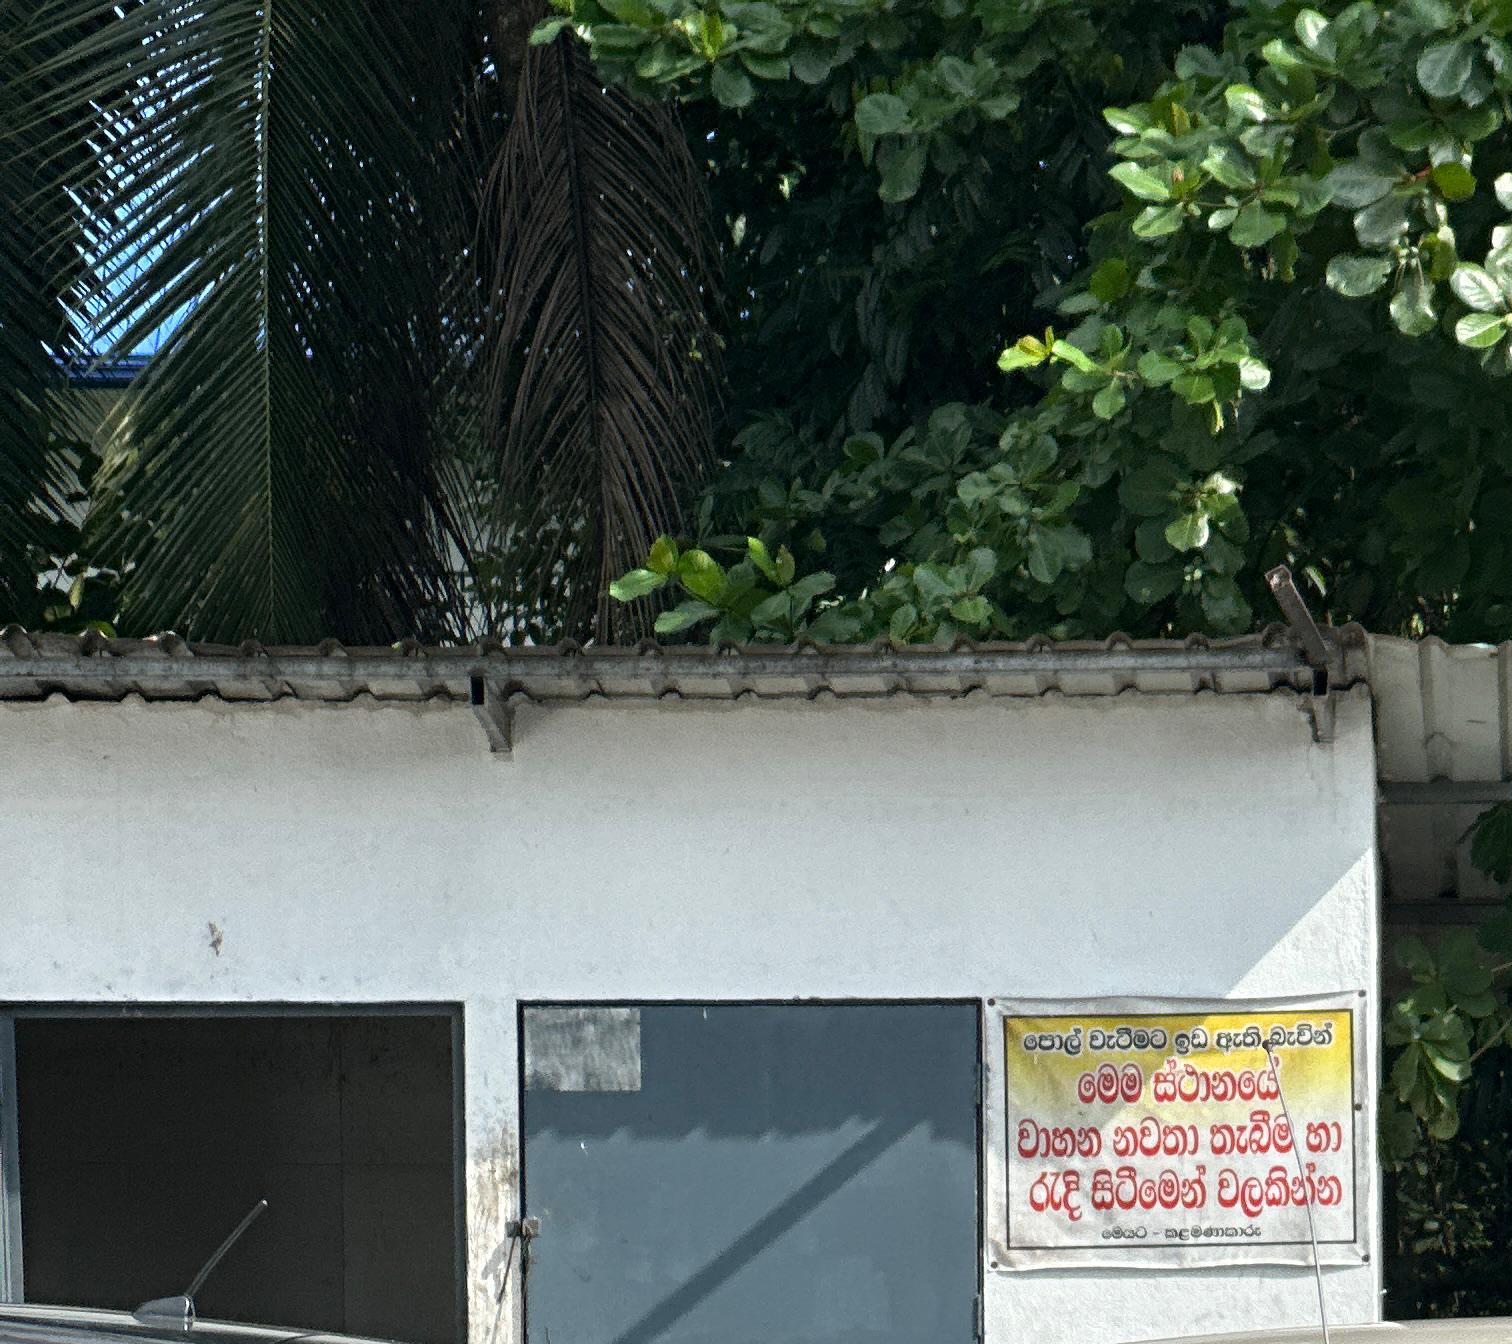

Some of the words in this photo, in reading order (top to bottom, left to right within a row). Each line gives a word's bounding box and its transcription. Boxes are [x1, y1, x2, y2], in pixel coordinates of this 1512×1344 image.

[1023, 1028, 1082, 1055] පොල්
[1089, 1027, 1167, 1050] වැටීමට
[1175, 1028, 1208, 1055] ඉඩ
[1216, 1026, 1262, 1051] ඇති
[1269, 1022, 1333, 1046] බැවින්
[1077, 1063, 1143, 1104] මෙම
[1153, 1057, 1281, 1103] ස්ථානයේ
[1017, 1118, 1102, 1158] වාහන
[1112, 1116, 1199, 1157] නවතා
[1210, 1109, 1295, 1155] තැබීම
[1306, 1122, 1342, 1153] හා
[1091, 1164, 1207, 1210] සිටීමෙන්
[1217, 1161, 1343, 1218] වලකින්න
